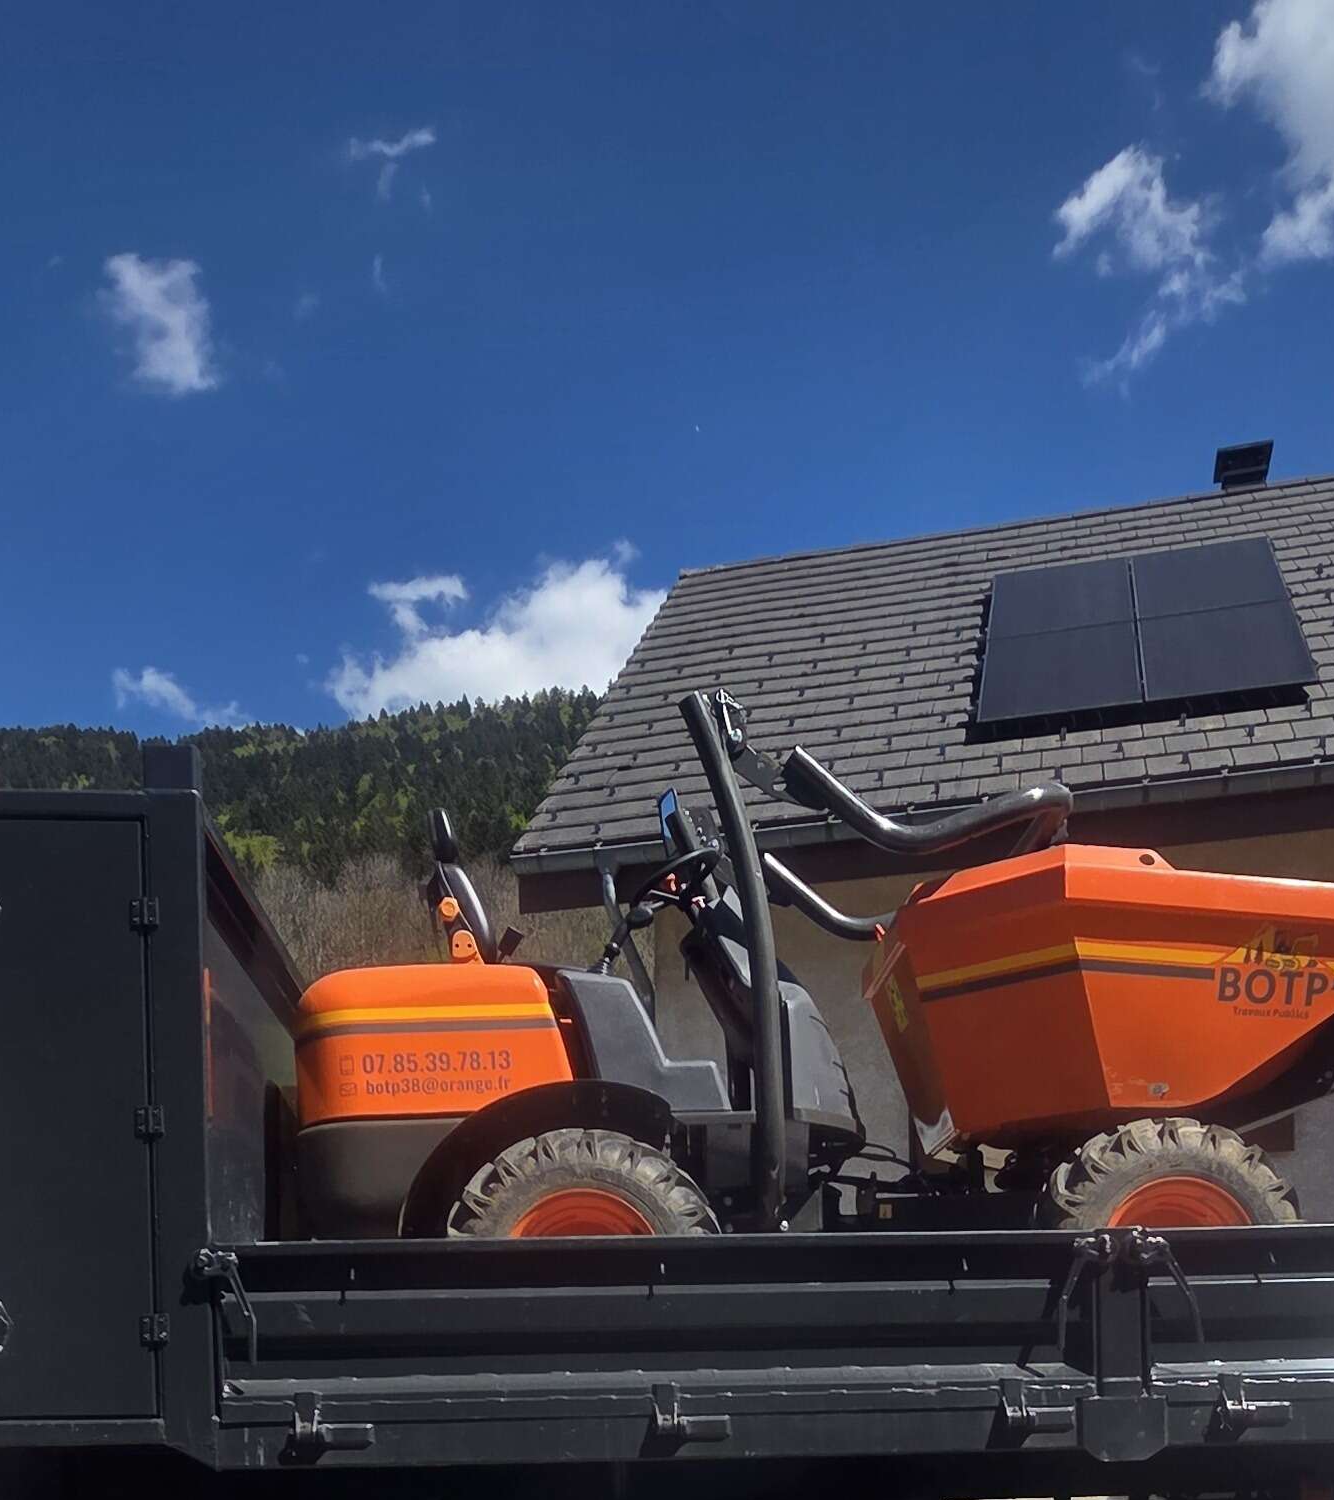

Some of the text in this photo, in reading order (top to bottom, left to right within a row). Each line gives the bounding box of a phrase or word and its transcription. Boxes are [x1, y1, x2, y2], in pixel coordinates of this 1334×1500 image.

[1217, 966, 1329, 1007] BOTP
[362, 1050, 511, 1075] 07.85.39.78.13
[365, 1075, 510, 1096] botp38@orange.fr
